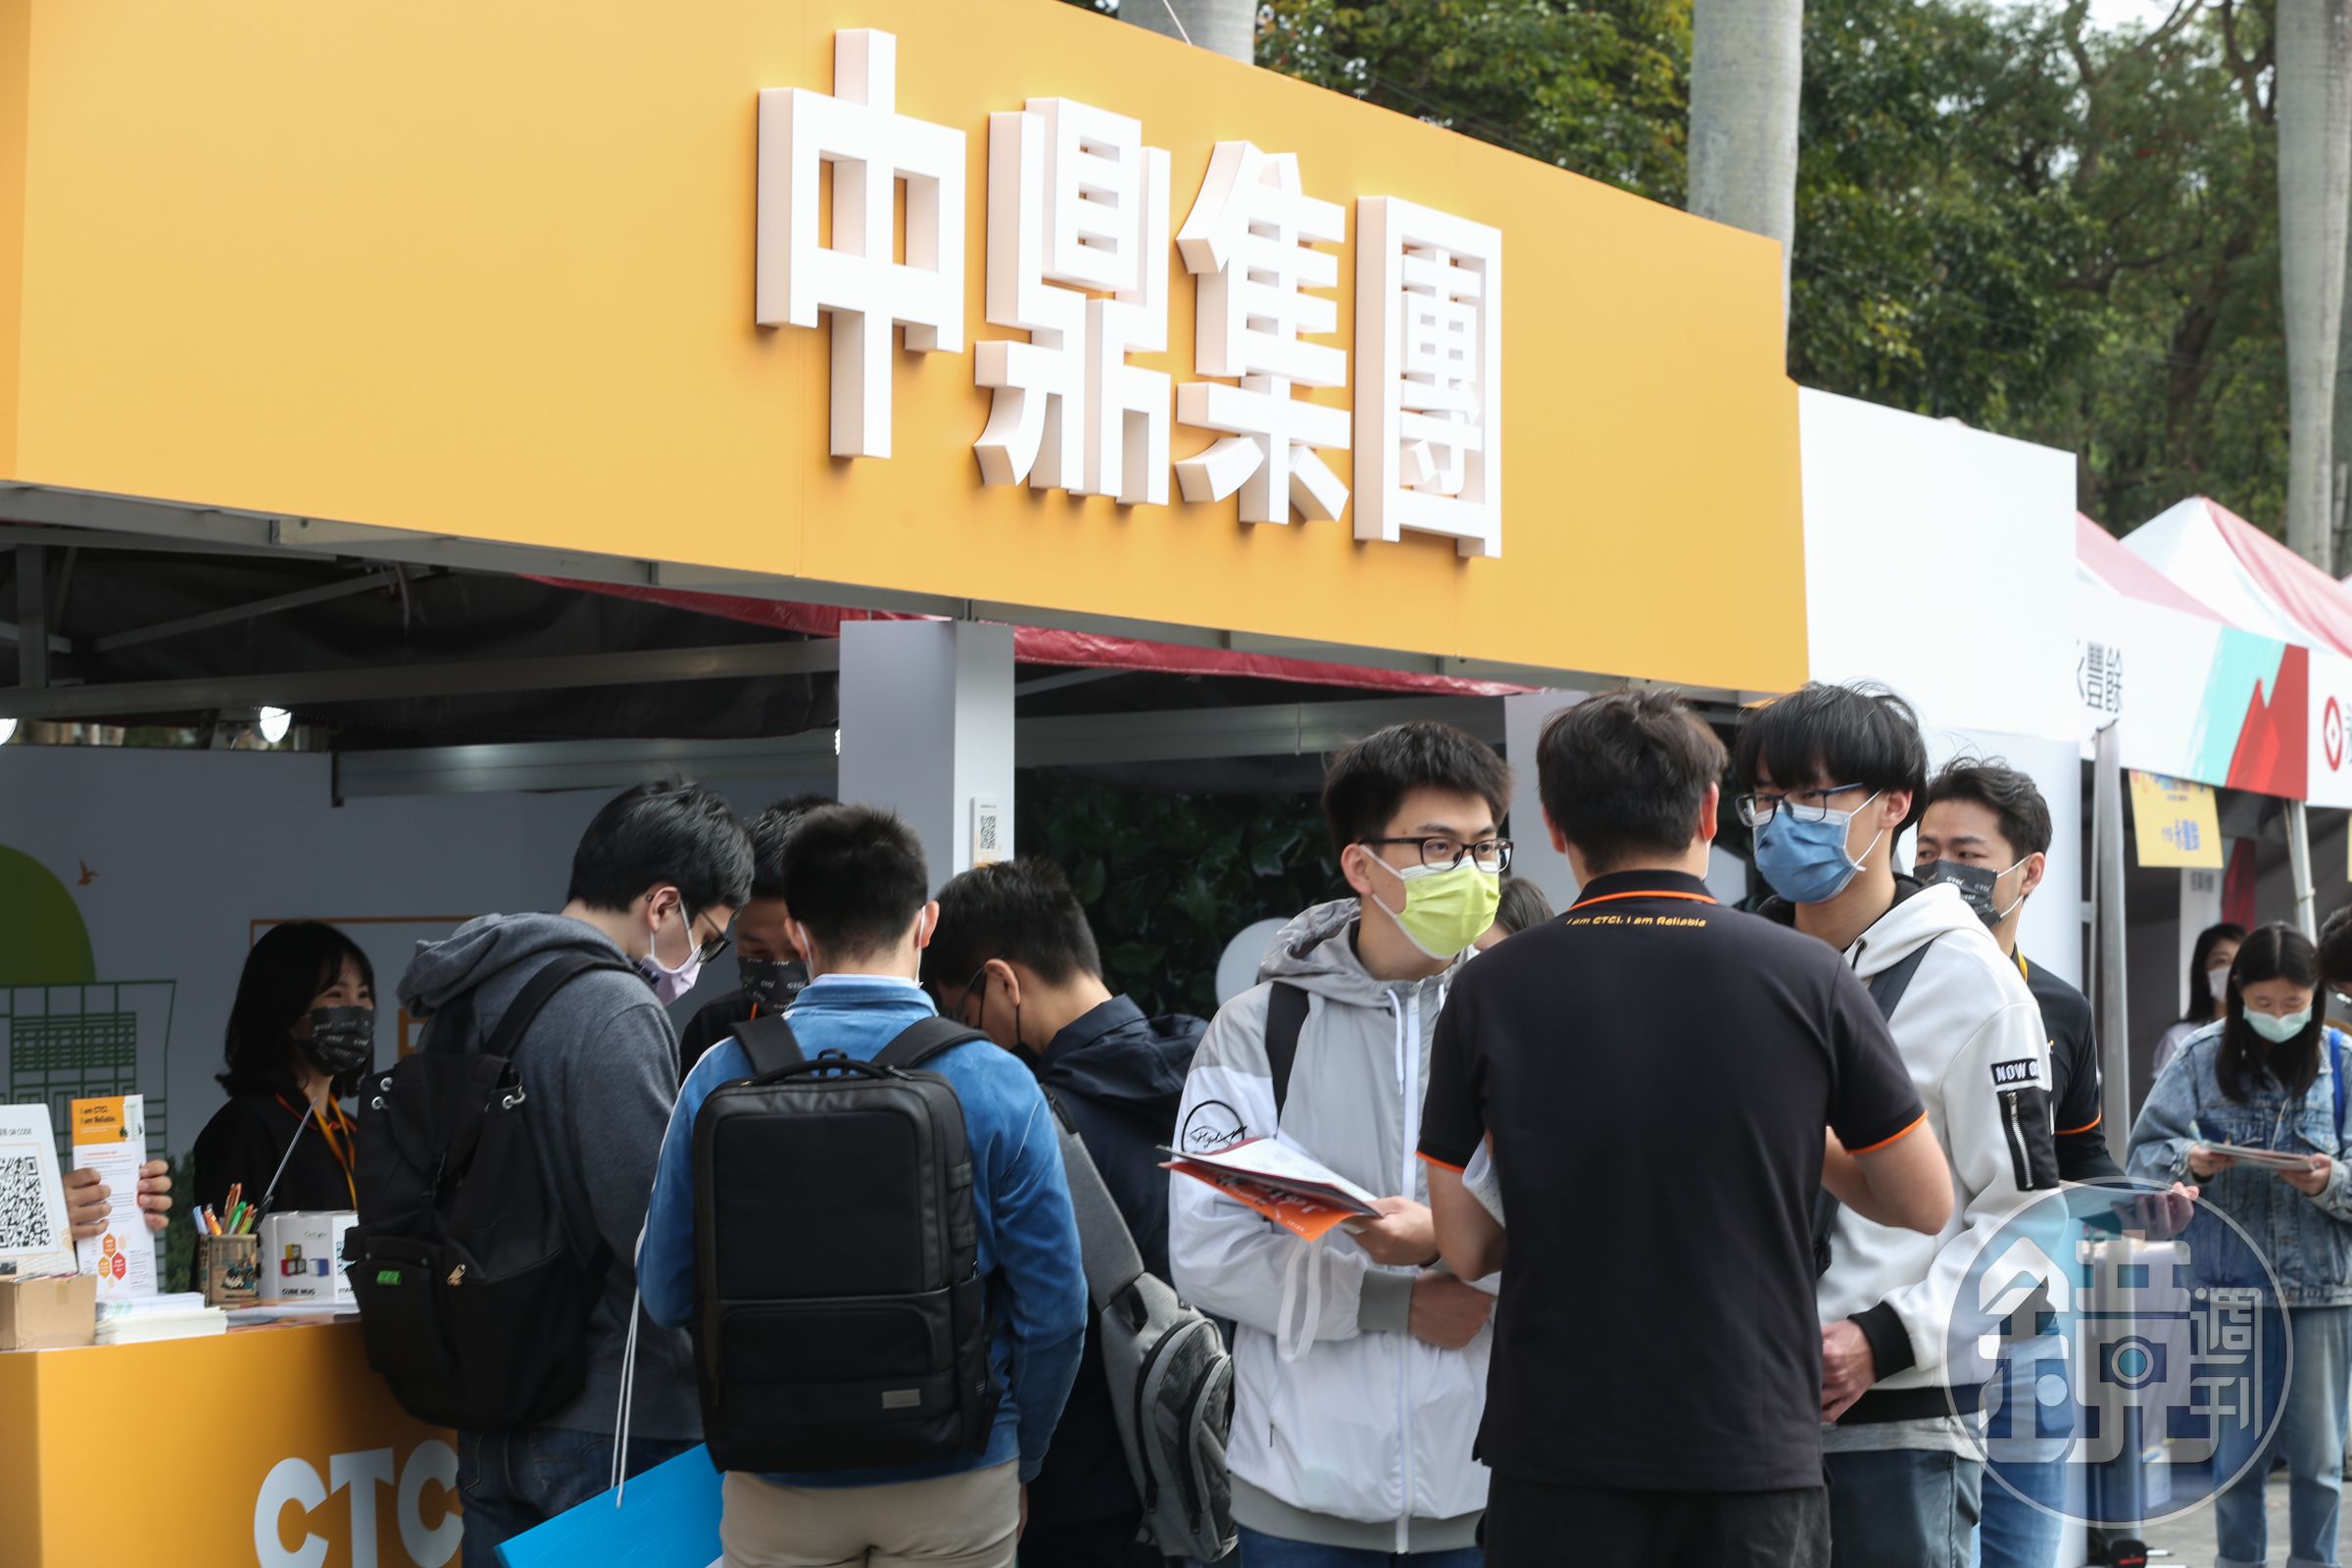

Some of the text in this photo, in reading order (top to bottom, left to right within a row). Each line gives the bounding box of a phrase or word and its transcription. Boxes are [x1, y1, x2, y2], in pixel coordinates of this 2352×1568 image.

[757, 27, 1502, 559] 中鼎集團
[1633, 916, 1653, 925] am
[1656, 915, 1707, 927] Reliable
[1995, 1061, 2027, 1082] NOW
